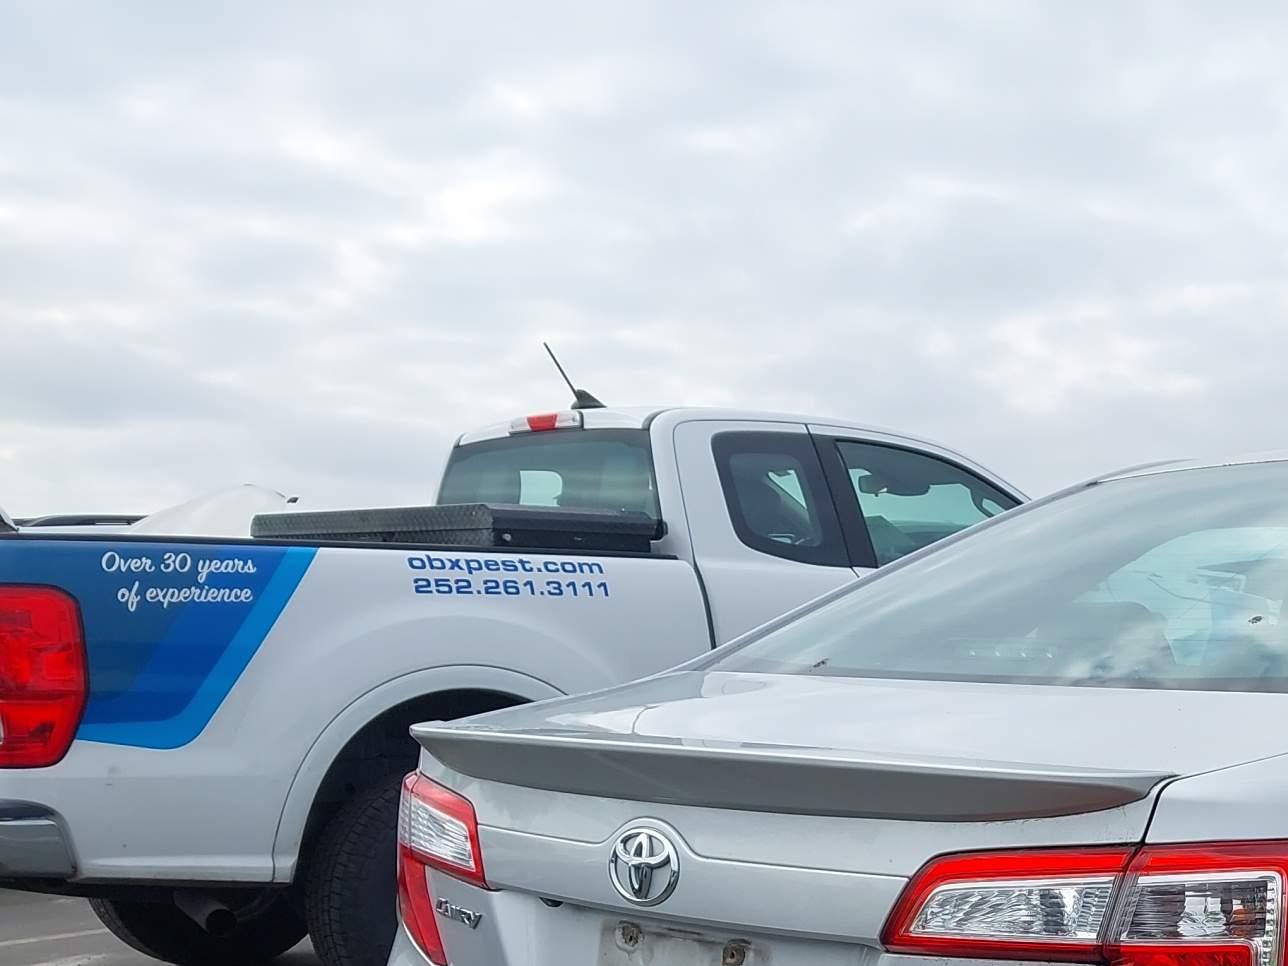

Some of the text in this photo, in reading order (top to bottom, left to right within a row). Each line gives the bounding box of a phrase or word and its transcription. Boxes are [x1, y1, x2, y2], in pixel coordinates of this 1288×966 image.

[101, 551, 256, 583] Over 30 years
[407, 554, 604, 575] obxpest.com
[117, 580, 253, 612] of experience
[413, 577, 609, 597] 252.261.3111
